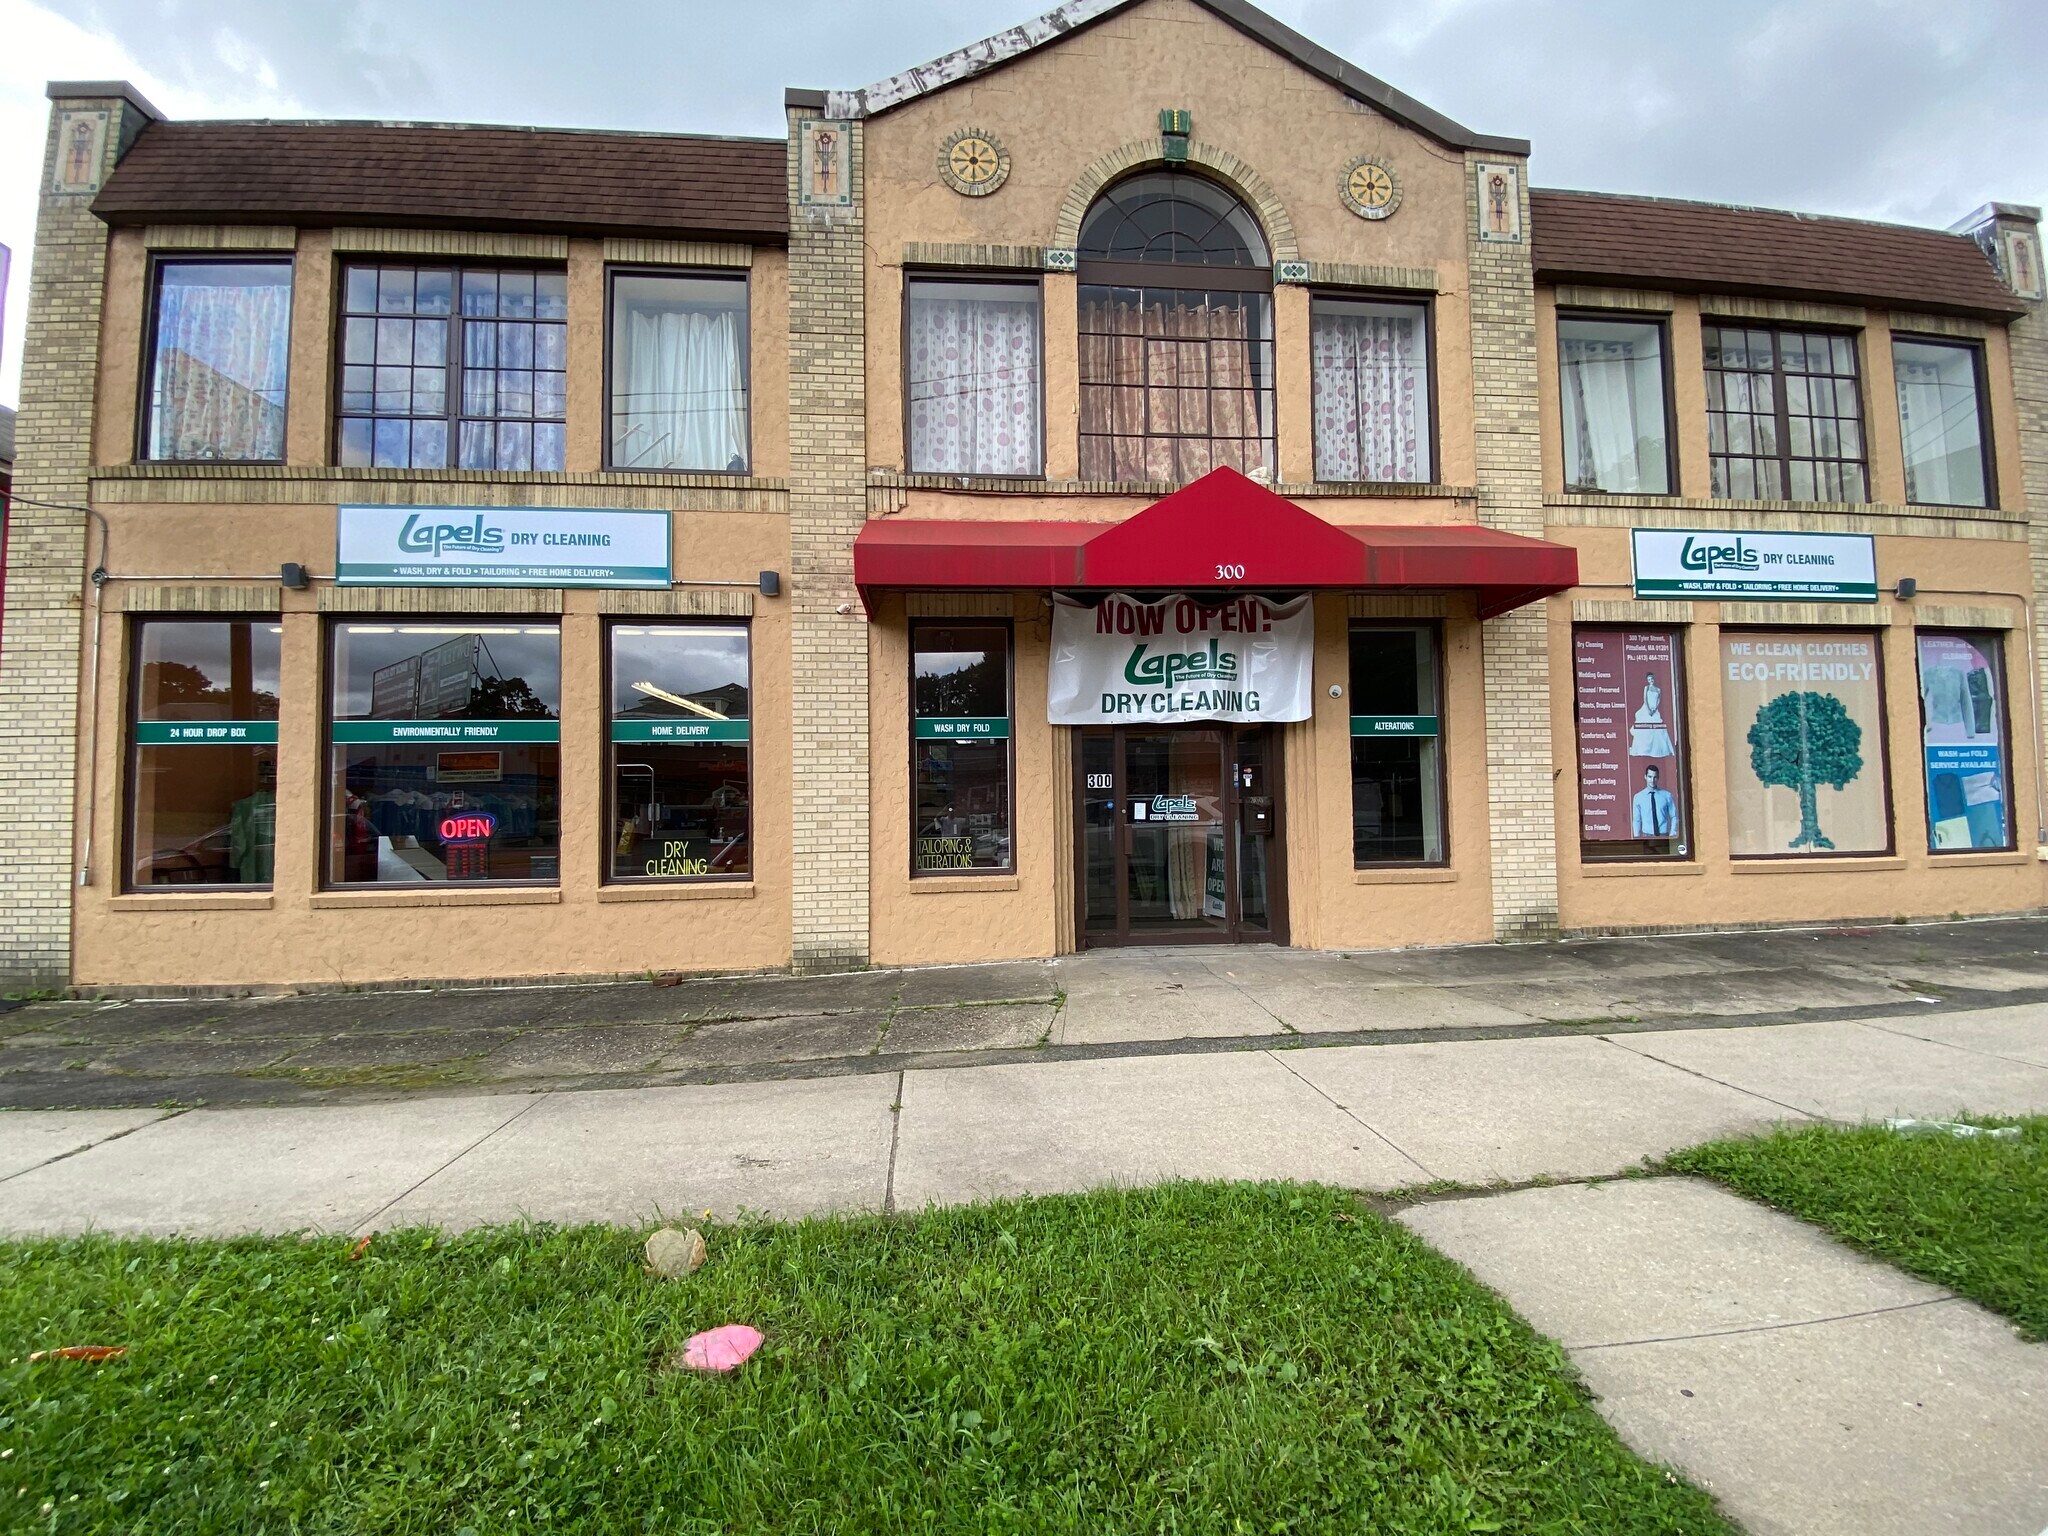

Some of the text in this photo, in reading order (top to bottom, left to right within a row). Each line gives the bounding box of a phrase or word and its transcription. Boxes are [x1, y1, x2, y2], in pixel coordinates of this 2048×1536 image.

[398, 514, 503, 557] Lapels
[511, 533, 611, 546] DRY CLEANING
[1680, 537, 1758, 574] Lapels
[1763, 553, 1835, 565] DRY CLEANING
[400, 567, 425, 576] WASH,
[426, 567, 442, 575] DRY
[480, 568, 520, 576] TAILORING
[529, 568, 548, 576] FREE
[549, 568, 571, 577] HOME
[573, 569, 609, 577] DELIVERY
[1214, 564, 1245, 580] 300
[1683, 582, 1702, 590] WASH,
[1703, 582, 1715, 590] DRY
[1743, 583, 1772, 591] TAILORING
[1778, 583, 1792, 591] FREE
[1810, 584, 1836, 592] DELIVERY
[1096, 600, 1272, 636] NOW OPEN!
[1730, 643, 1868, 656] WE CLEAN CLOTHES
[1124, 638, 1237, 689] Lapels
[1578, 656, 1595, 664] Laundry
[1727, 662, 1873, 681] ECO-FRIENDLY
[1101, 689, 1260, 713] DRY CLEANING
[170, 727, 246, 738] 24 HOUR DROP BOX
[393, 727, 499, 736] ENVIRONMENTALLY FRIENDLY
[652, 726, 709, 736] HOME DELIVERY
[934, 724, 990, 732] WASH DRY FOLD
[1374, 721, 1414, 731] ALTERATIONS
[1930, 761, 1959, 769] SERVICE
[1088, 774, 1112, 788] 300
[1152, 795, 1196, 813] Lapels
[441, 819, 490, 838] OPEN
[664, 841, 689, 858] DRY
[917, 838, 972, 853] TAILORING &
[1213, 837, 1224, 851] WE
[645, 859, 708, 876] CLEANING
[1211, 858, 1224, 872] ARE
[1207, 878, 1225, 893] OPEN
